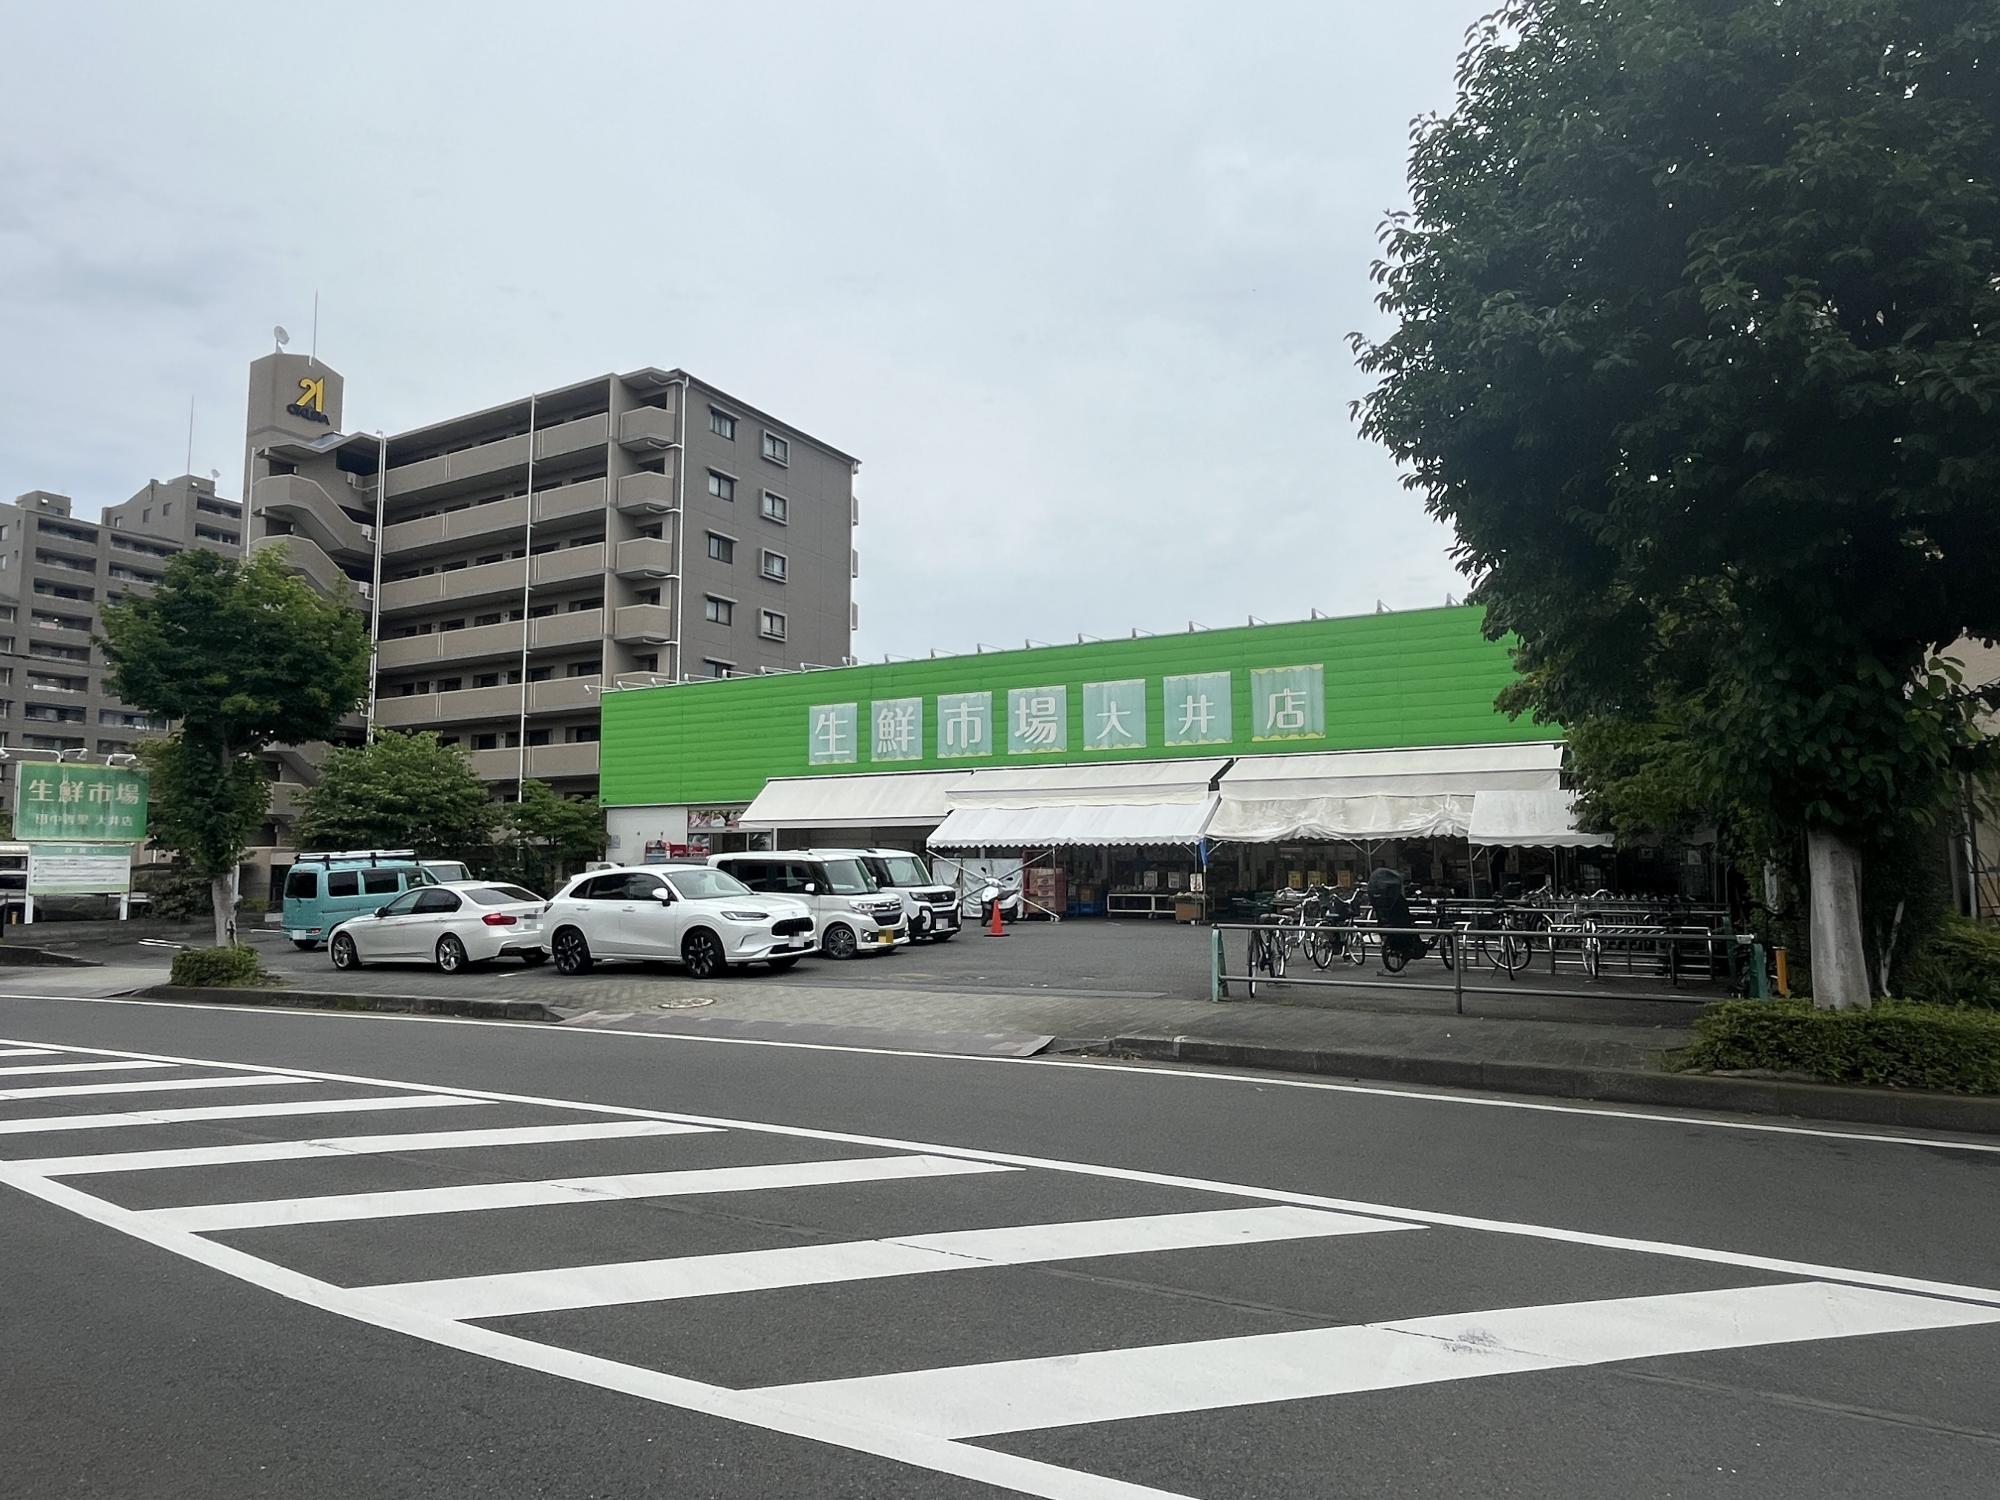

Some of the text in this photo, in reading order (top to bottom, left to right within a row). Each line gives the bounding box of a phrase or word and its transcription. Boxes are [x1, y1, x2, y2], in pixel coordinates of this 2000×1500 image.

[814, 687, 1308, 756] 生鮮市場大井店
[28, 778, 140, 805] 生鮮市場
